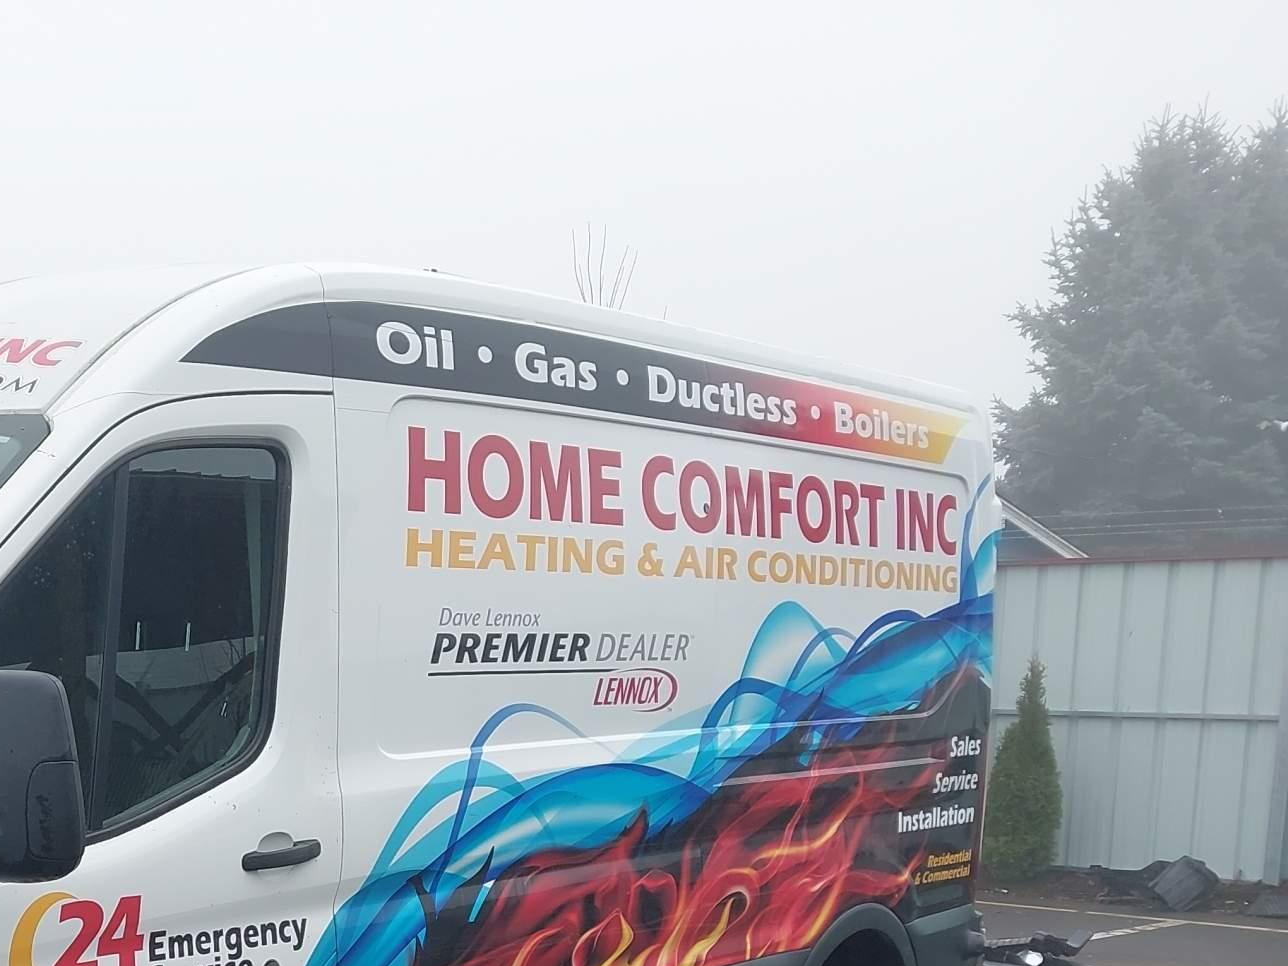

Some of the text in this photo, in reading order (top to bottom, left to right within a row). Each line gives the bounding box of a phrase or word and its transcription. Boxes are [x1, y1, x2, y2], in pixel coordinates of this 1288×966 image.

[374, 320, 930, 450] Oil Gas Ductless Boilers
[406, 425, 959, 557] HOME COMFORT INC
[404, 526, 959, 595] HEATING & AIR CONDITIONING
[438, 606, 541, 628] Dave Lennox
[429, 632, 690, 665] PREMIER DEALER
[592, 675, 664, 706] LENNOX
[949, 735, 982, 758] Sales
[931, 769, 979, 794] Service
[897, 804, 975, 834] Installation
[927, 849, 972, 868] Residential
[914, 864, 971, 886] & Commercial
[148, 917, 308, 963] Emergency
